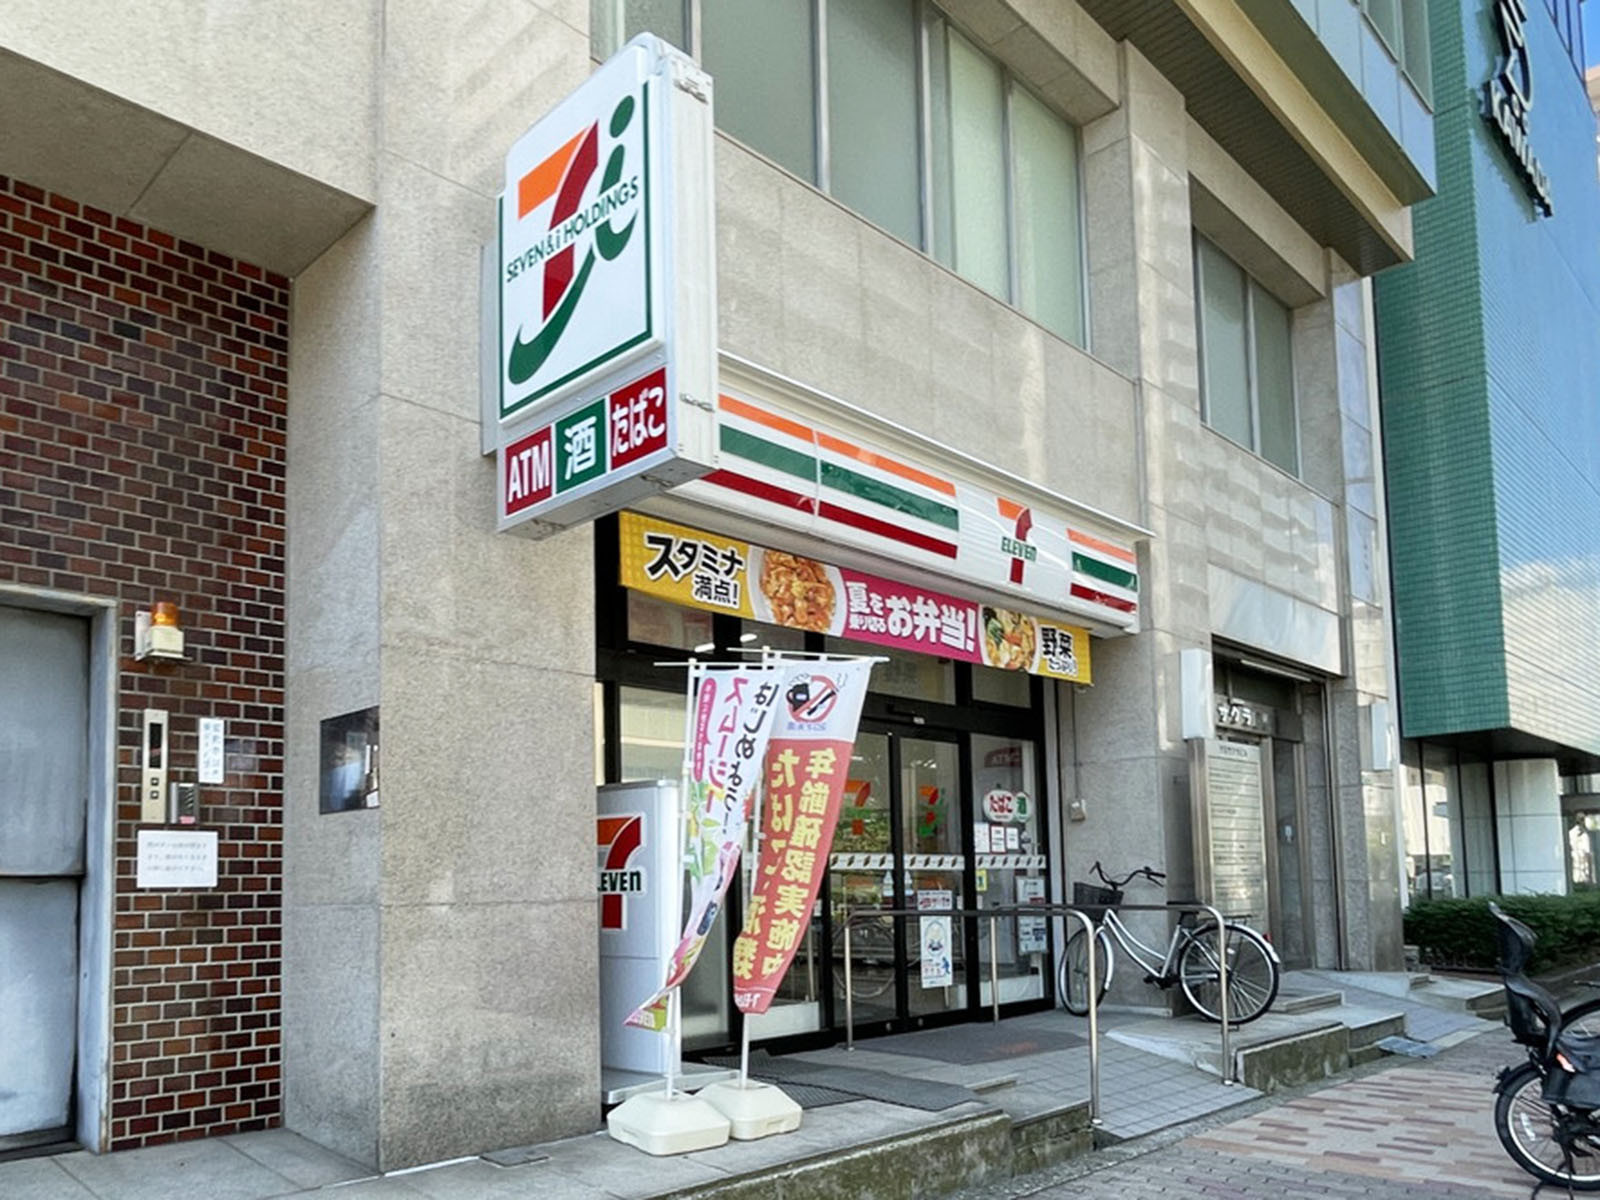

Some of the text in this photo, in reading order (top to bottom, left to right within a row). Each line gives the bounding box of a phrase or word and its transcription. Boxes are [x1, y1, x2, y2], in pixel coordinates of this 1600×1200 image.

[564, 175, 640, 244] HOLDINGS
[564, 415, 597, 480] 酒
[612, 386, 666, 457] たばこ
[508, 440, 550, 503] ATM
[644, 533, 744, 578] スタミナ
[885, 594, 977, 653] お弁当!
